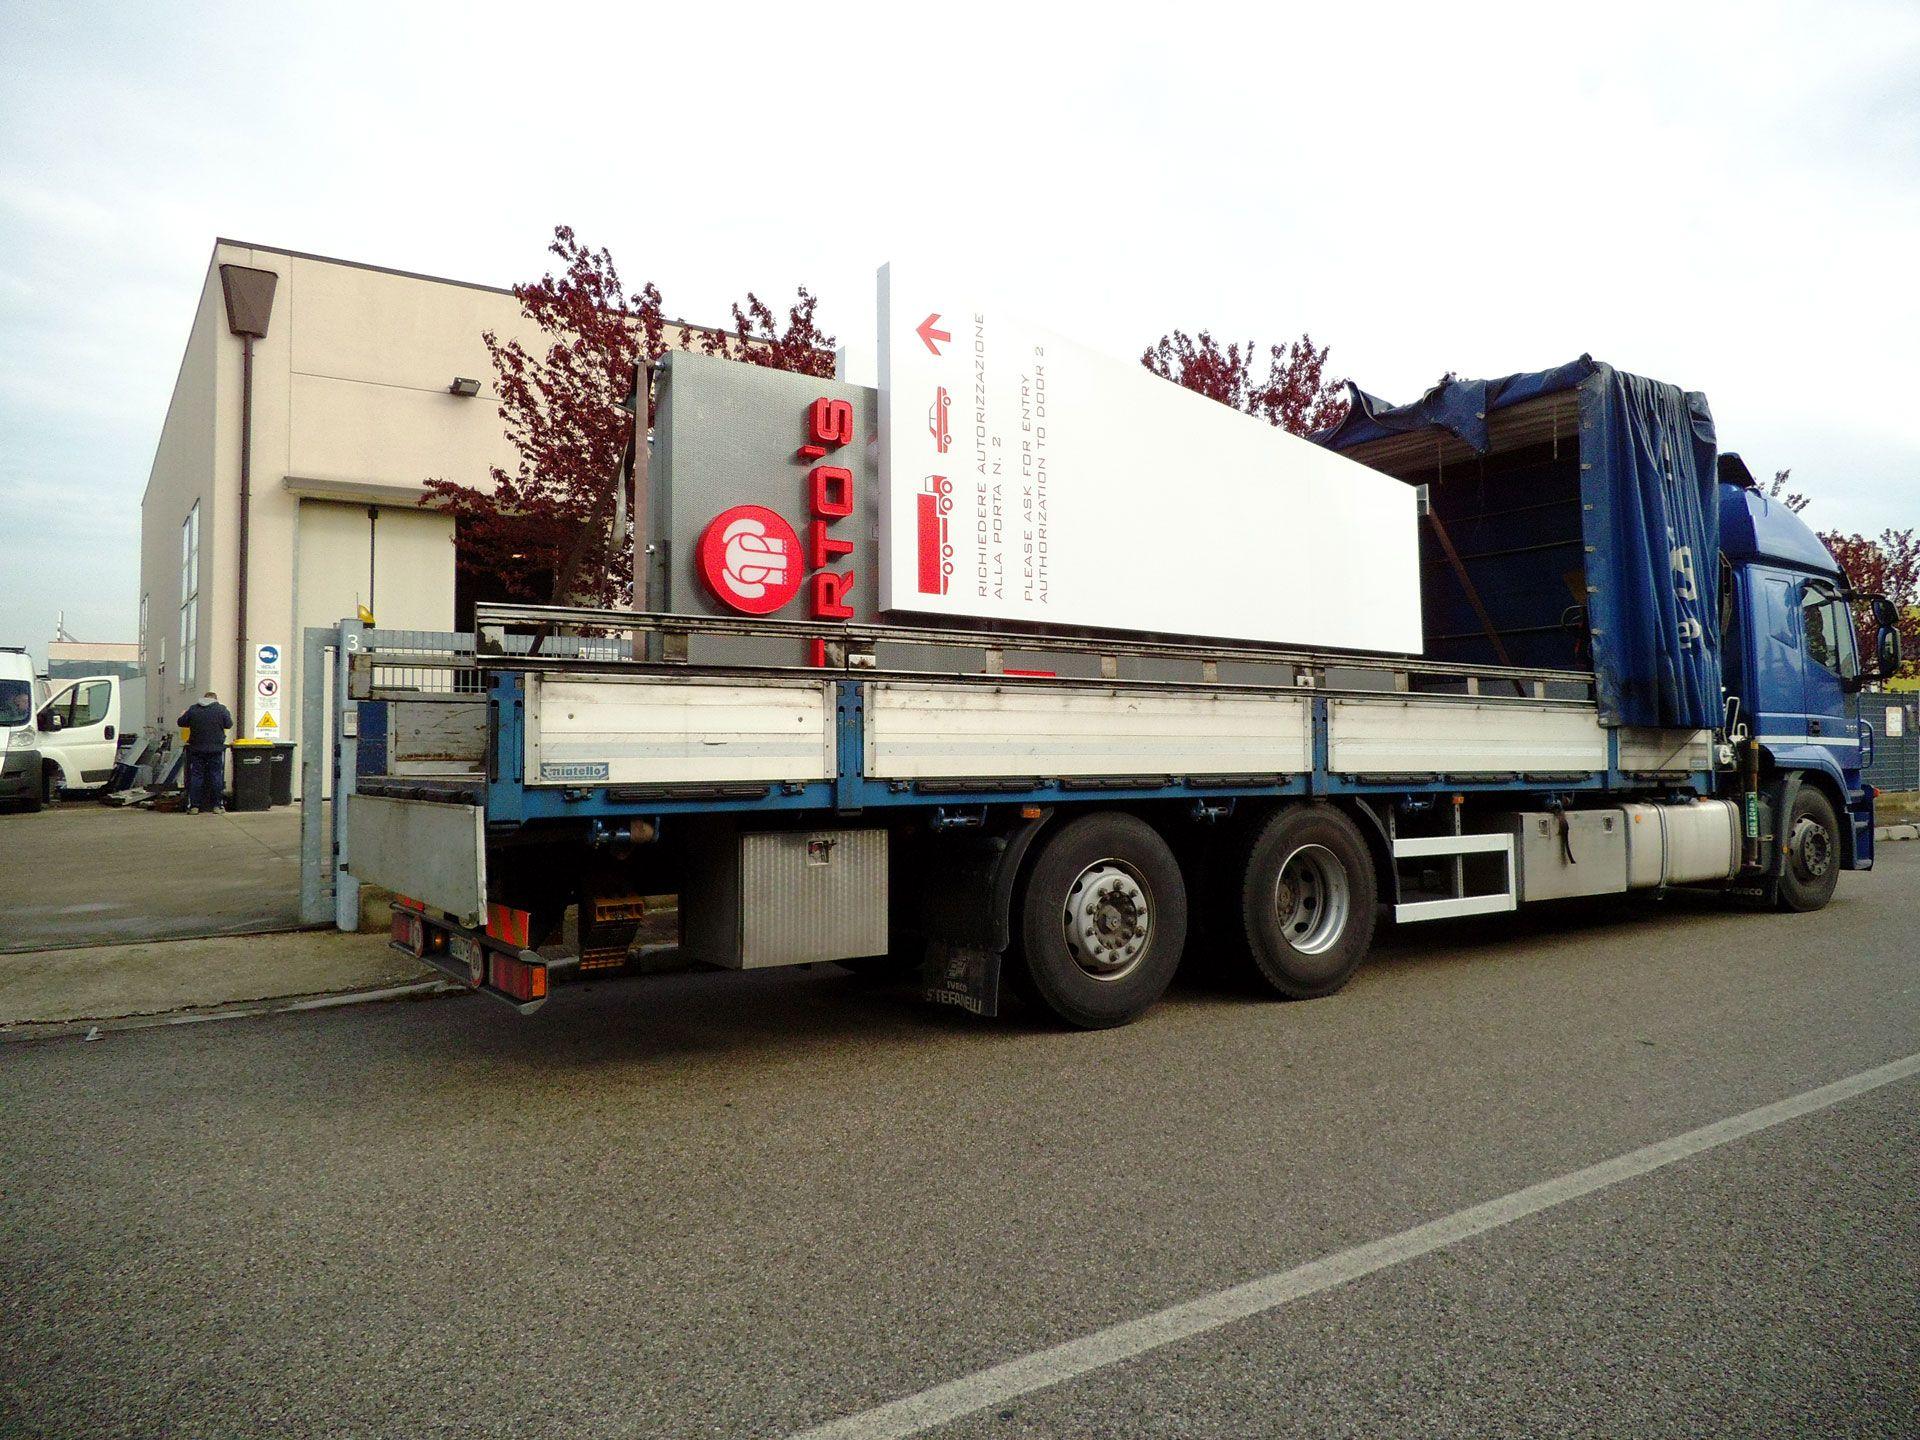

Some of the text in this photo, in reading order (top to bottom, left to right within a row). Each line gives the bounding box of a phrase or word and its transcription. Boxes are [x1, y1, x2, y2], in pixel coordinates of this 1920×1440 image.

[797, 396, 854, 668] RTO'S
[974, 312, 987, 597] RICHIEDERE AUTORIZZAZIONE
[992, 436, 1003, 600] ALLA PORTA N. 2
[1021, 373, 1033, 601] PLEASE ASK FOR ENTRY
[1035, 346, 1048, 604] AUTHORIZATION TO DOOR 2
[347, 634, 358, 651] 3
